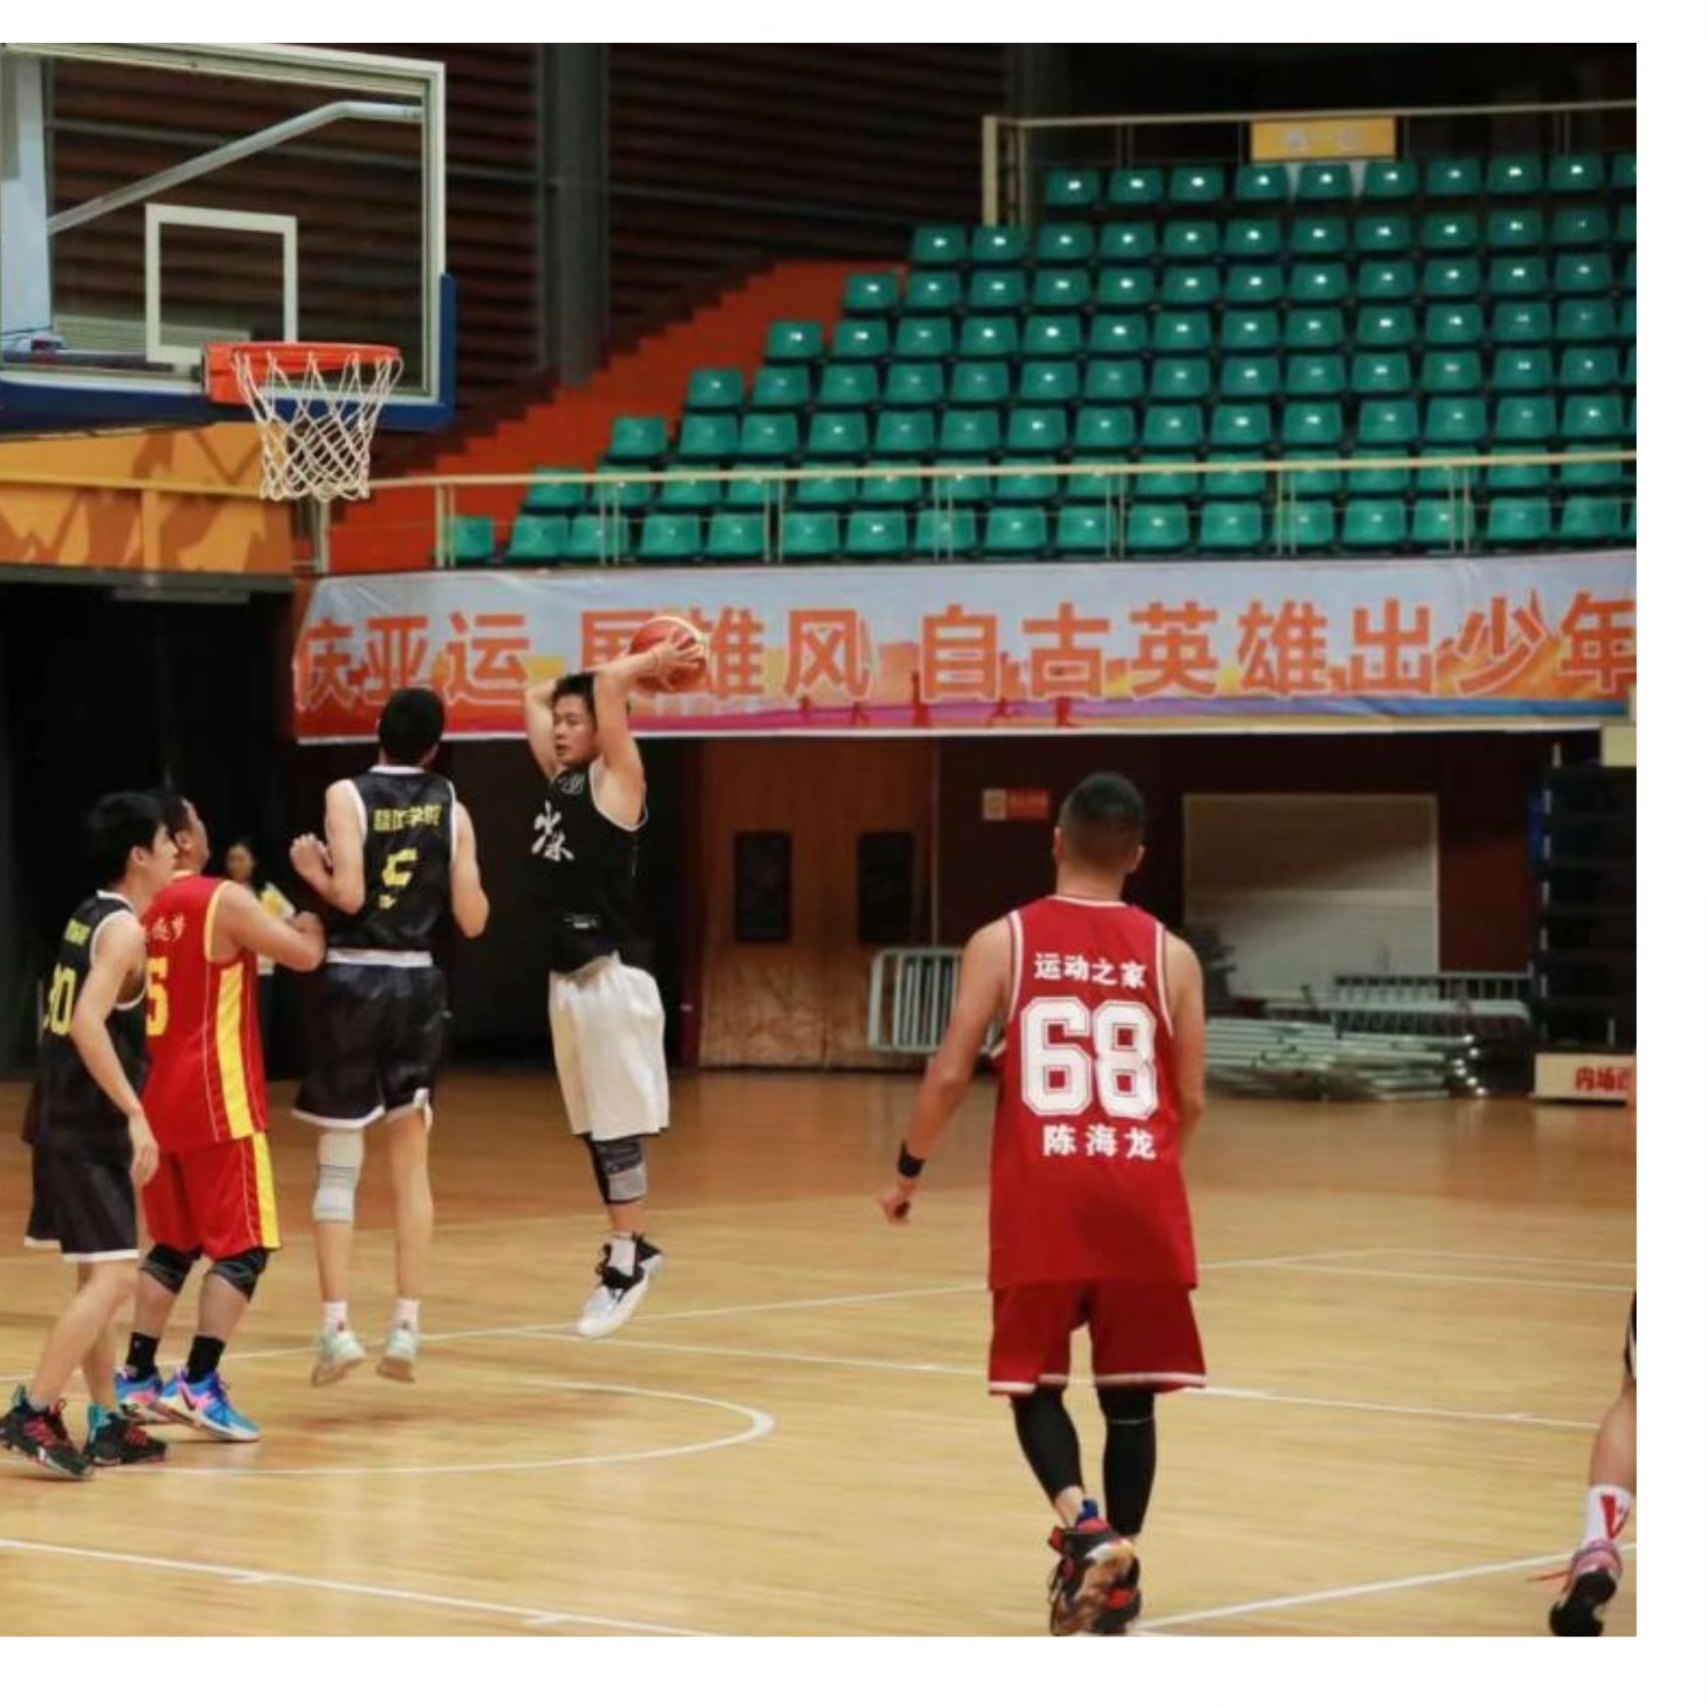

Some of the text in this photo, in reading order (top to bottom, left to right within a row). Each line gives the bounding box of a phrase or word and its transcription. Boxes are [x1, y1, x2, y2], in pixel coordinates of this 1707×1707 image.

[922, 598, 1635, 699] 自古英雄出少年
[1033, 952, 1147, 989] 运动之家
[1020, 996, 1159, 1121] 68
[1042, 1122, 1157, 1160] 陈海龙
